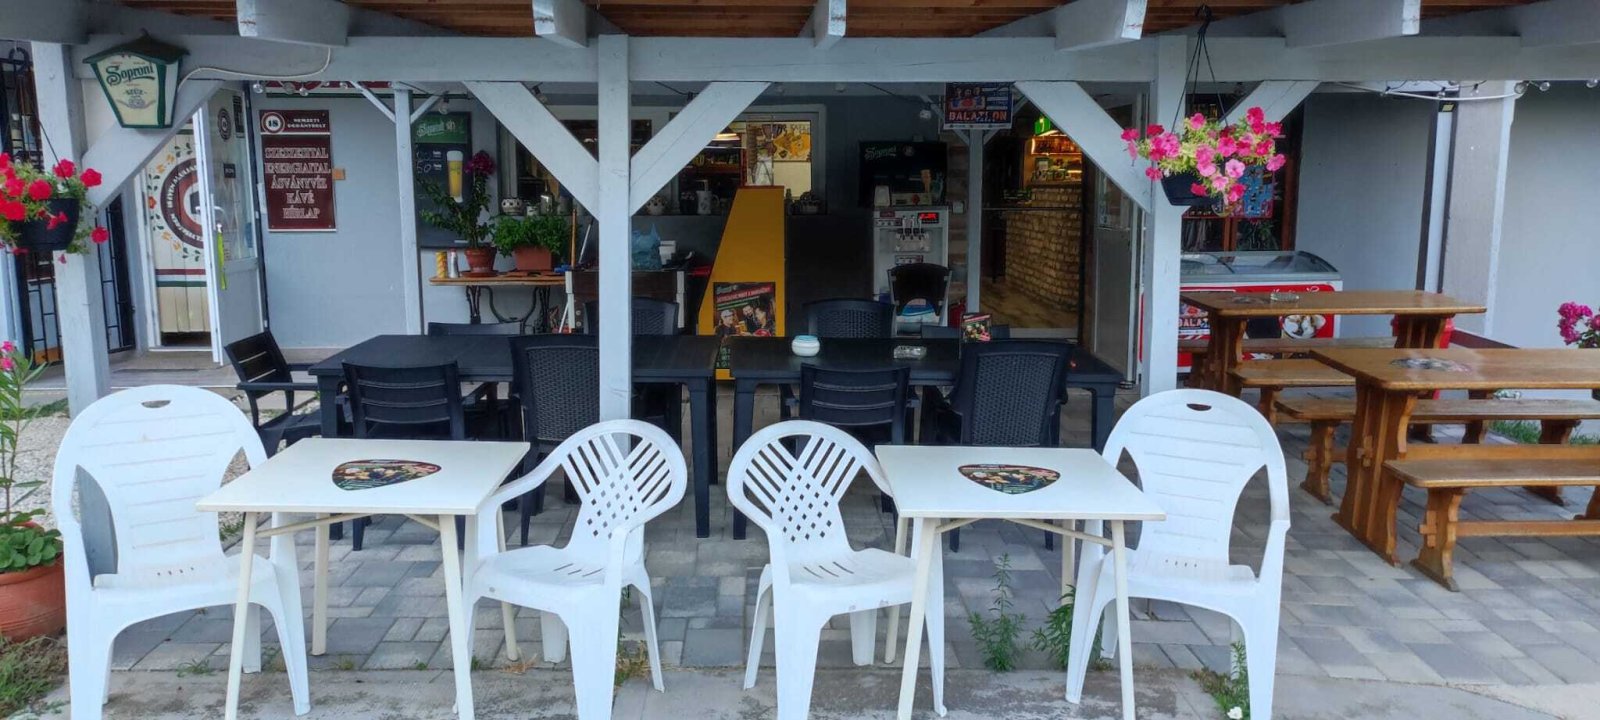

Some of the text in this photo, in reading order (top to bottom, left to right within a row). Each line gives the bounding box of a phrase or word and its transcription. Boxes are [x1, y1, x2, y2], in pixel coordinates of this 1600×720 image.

[105, 61, 155, 86] Soproni
[268, 119, 278, 128] 18
[264, 162, 331, 174] ENERGIAITAL
[271, 174, 327, 189] ÁSVÁNYVÍZ
[286, 189, 315, 204] KÁVÉ
[283, 205, 320, 219] HÍRLAP
